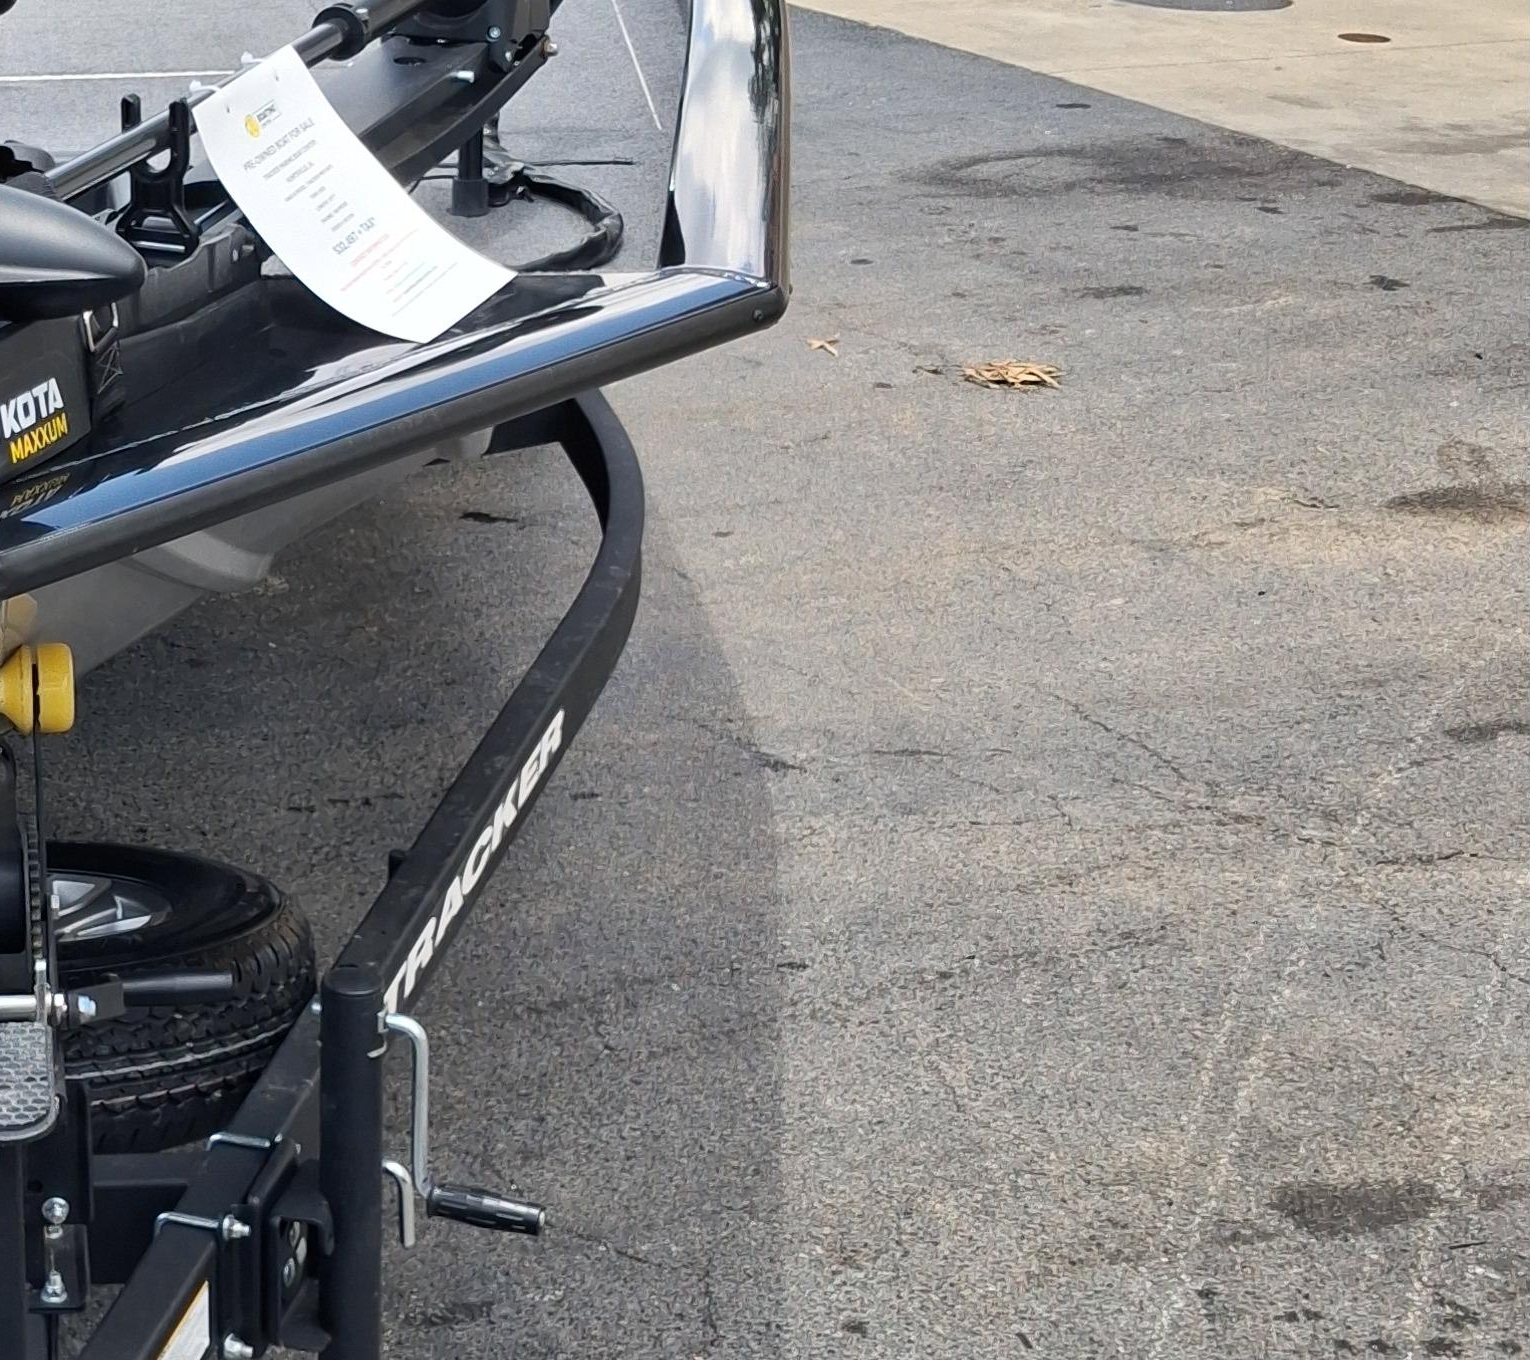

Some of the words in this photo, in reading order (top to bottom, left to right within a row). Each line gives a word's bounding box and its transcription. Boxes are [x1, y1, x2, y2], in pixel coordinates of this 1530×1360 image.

[0, 377, 64, 439] KOTA
[9, 412, 68, 464] MAXXUM
[383, 707, 566, 1015] TRACKER
